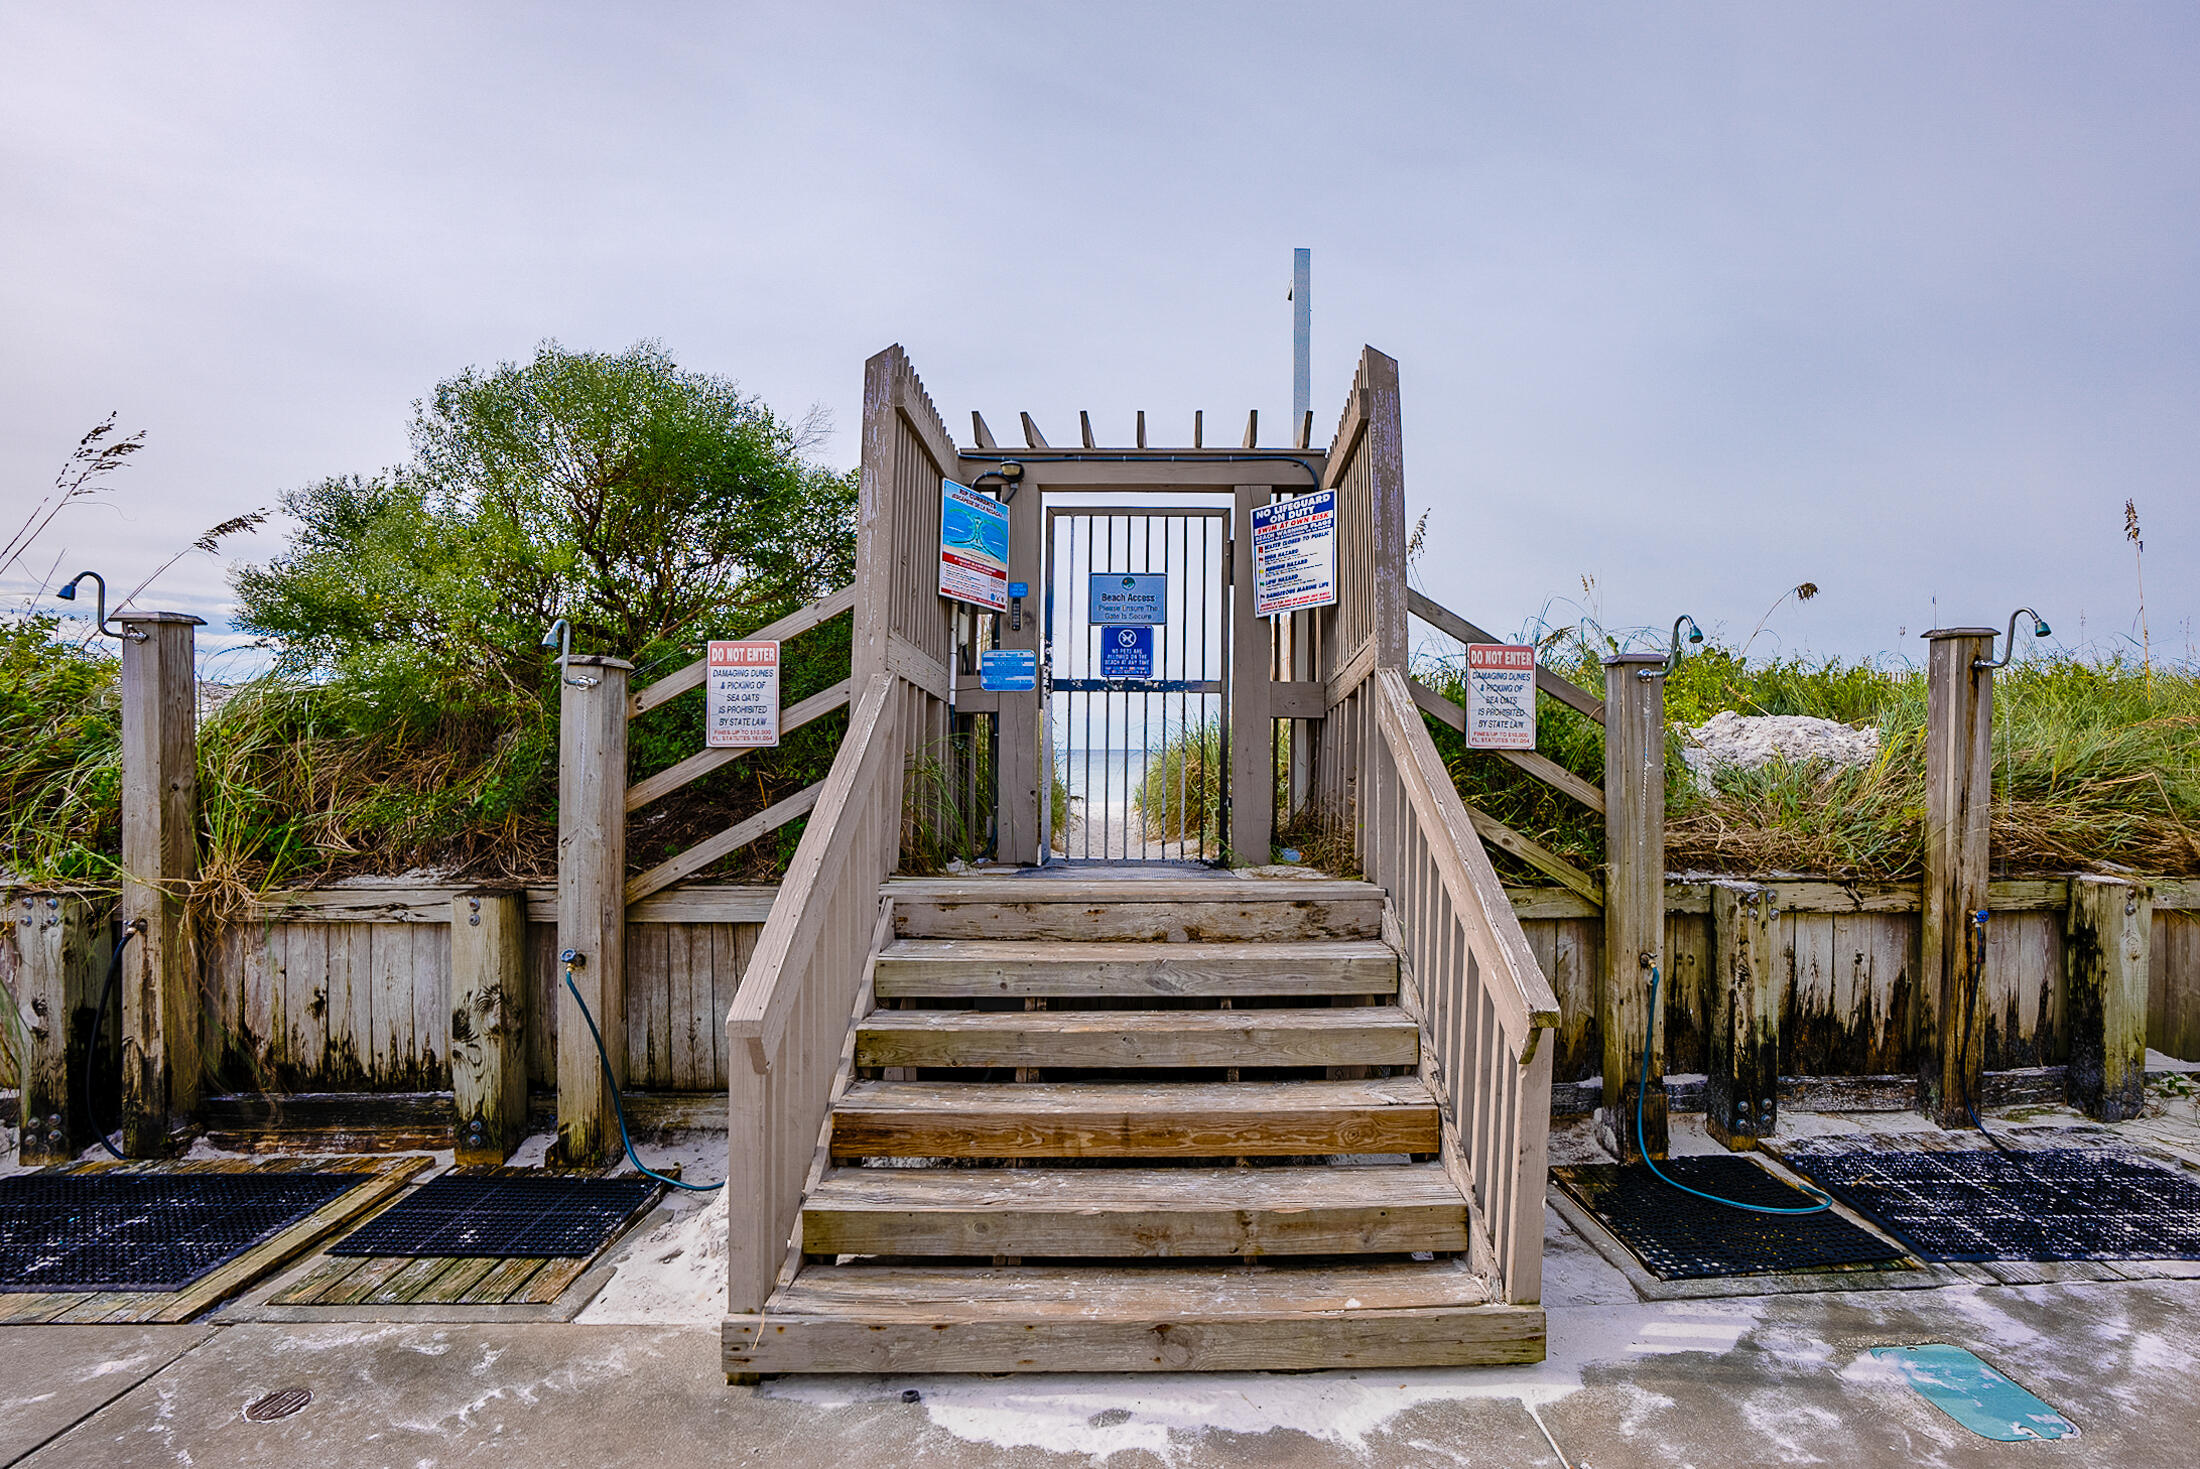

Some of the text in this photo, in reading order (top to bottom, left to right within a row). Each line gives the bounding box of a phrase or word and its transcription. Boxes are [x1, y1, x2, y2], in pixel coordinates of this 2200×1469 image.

[1256, 494, 1331, 520] NO LIFEGUARD
[1269, 506, 1316, 524] ON DUTY
[1257, 512, 1329, 534] SWIM AT OWN RISK
[1310, 518, 1332, 529] FLAGS
[1282, 537, 1301, 546] CLOSED
[1311, 530, 1330, 539] PUBLIC
[1278, 548, 1299, 557] HAZARD
[1286, 558, 1308, 568] HAZARD
[1278, 574, 1299, 582] HAZARD
[1296, 582, 1317, 592] MARINE
[1101, 593, 1155, 602] Beach Access
[712, 648, 776, 662] DO NOT ENTER
[1471, 650, 1532, 666] DO NOT ENTER
[712, 669, 774, 678] DAMAGING DUNES
[1472, 672, 1530, 681] DAMAGING DUNES
[1486, 684, 1513, 692] PICKING
[1514, 684, 1523, 692] OF
[1486, 696, 1517, 705] SEA OATS
[718, 706, 768, 714] IS PROHIBITED
[1478, 708, 1525, 716] IS PROHIBITED
[719, 718, 767, 726] BY STATE LAW
[1478, 720, 1524, 729] BY STATE LAW
